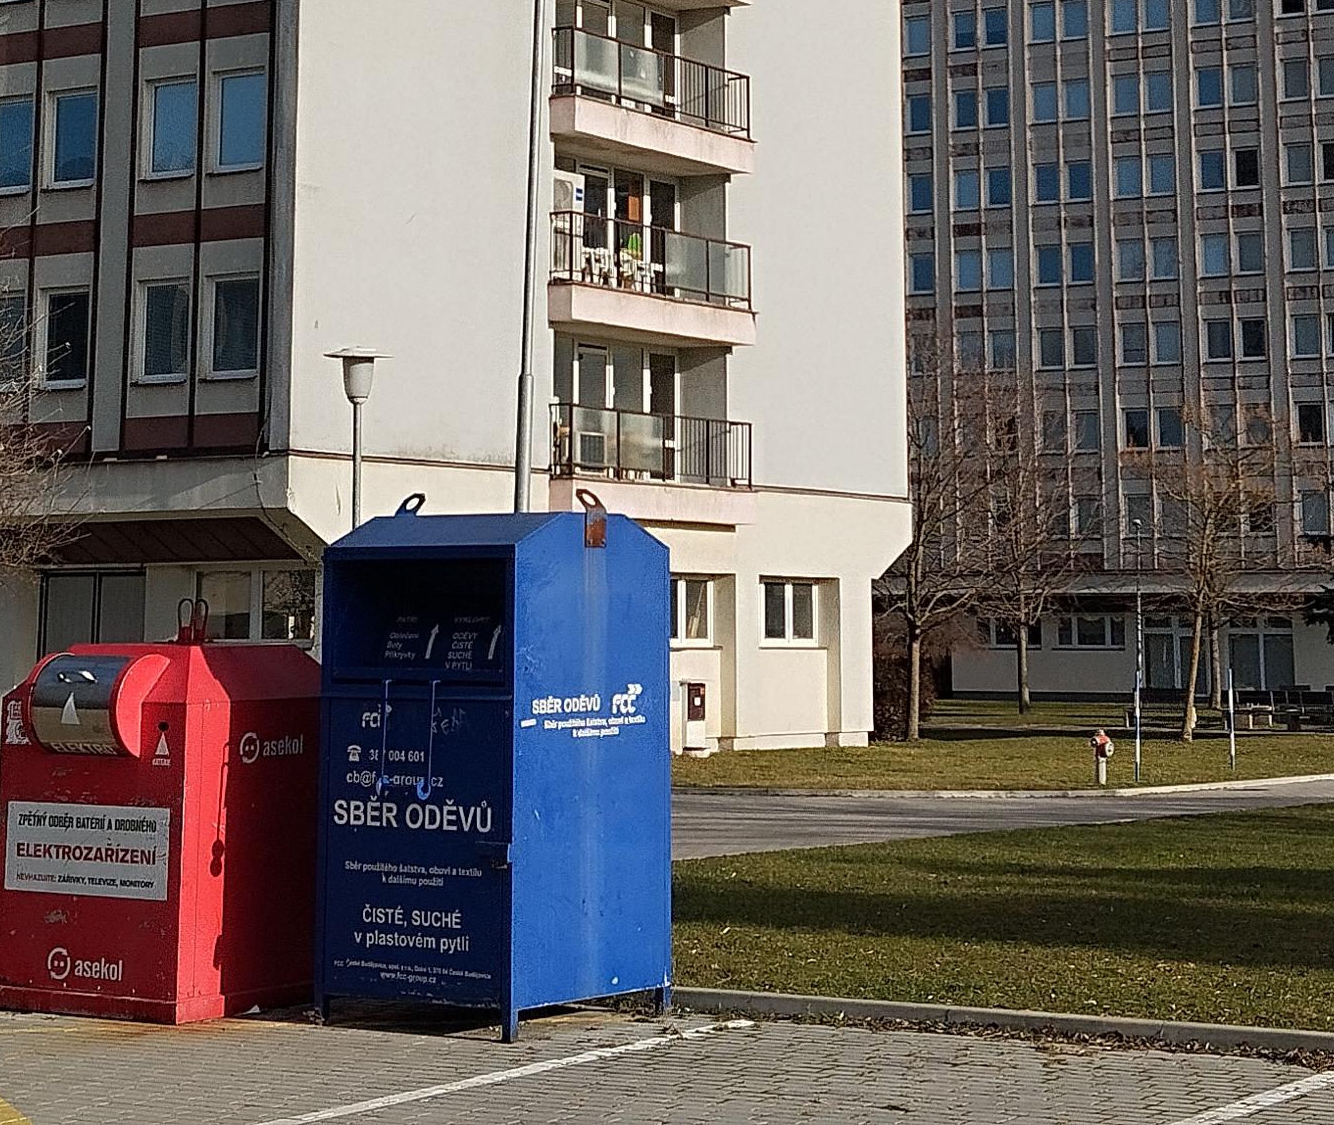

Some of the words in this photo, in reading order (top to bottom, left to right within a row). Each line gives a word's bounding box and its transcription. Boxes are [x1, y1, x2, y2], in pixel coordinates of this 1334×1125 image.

[532, 696, 562, 714] SBĚR
[564, 694, 600, 712] ODĚVŮ
[263, 734, 303, 756] asekol
[388, 750, 405, 762] 004
[408, 750, 424, 762] 601
[18, 810, 48, 826] ZPĚTNÝ
[48, 813, 74, 828] ODBĚR
[76, 814, 106, 830] BATERIÍ
[107, 818, 112, 830] A
[114, 816, 156, 833] DROBNÉHO
[334, 795, 398, 828] SBĚR
[406, 798, 492, 832] ODĚVŮ
[17, 842, 156, 865] ELEKTROZAŘÍZENÍ
[345, 860, 362, 870] Sběr
[429, 866, 450, 876] obuvi
[458, 867, 482, 877] textilu
[88, 878, 118, 888] TELEVIZE,
[120, 879, 154, 889] MONITORY
[362, 904, 407, 926] ČISTÉ,
[412, 910, 462, 928] SUCHÉ
[354, 932, 362, 943] v
[366, 930, 436, 948] plastovém
[440, 935, 469, 954] pytli
[74, 957, 122, 981] asekol
